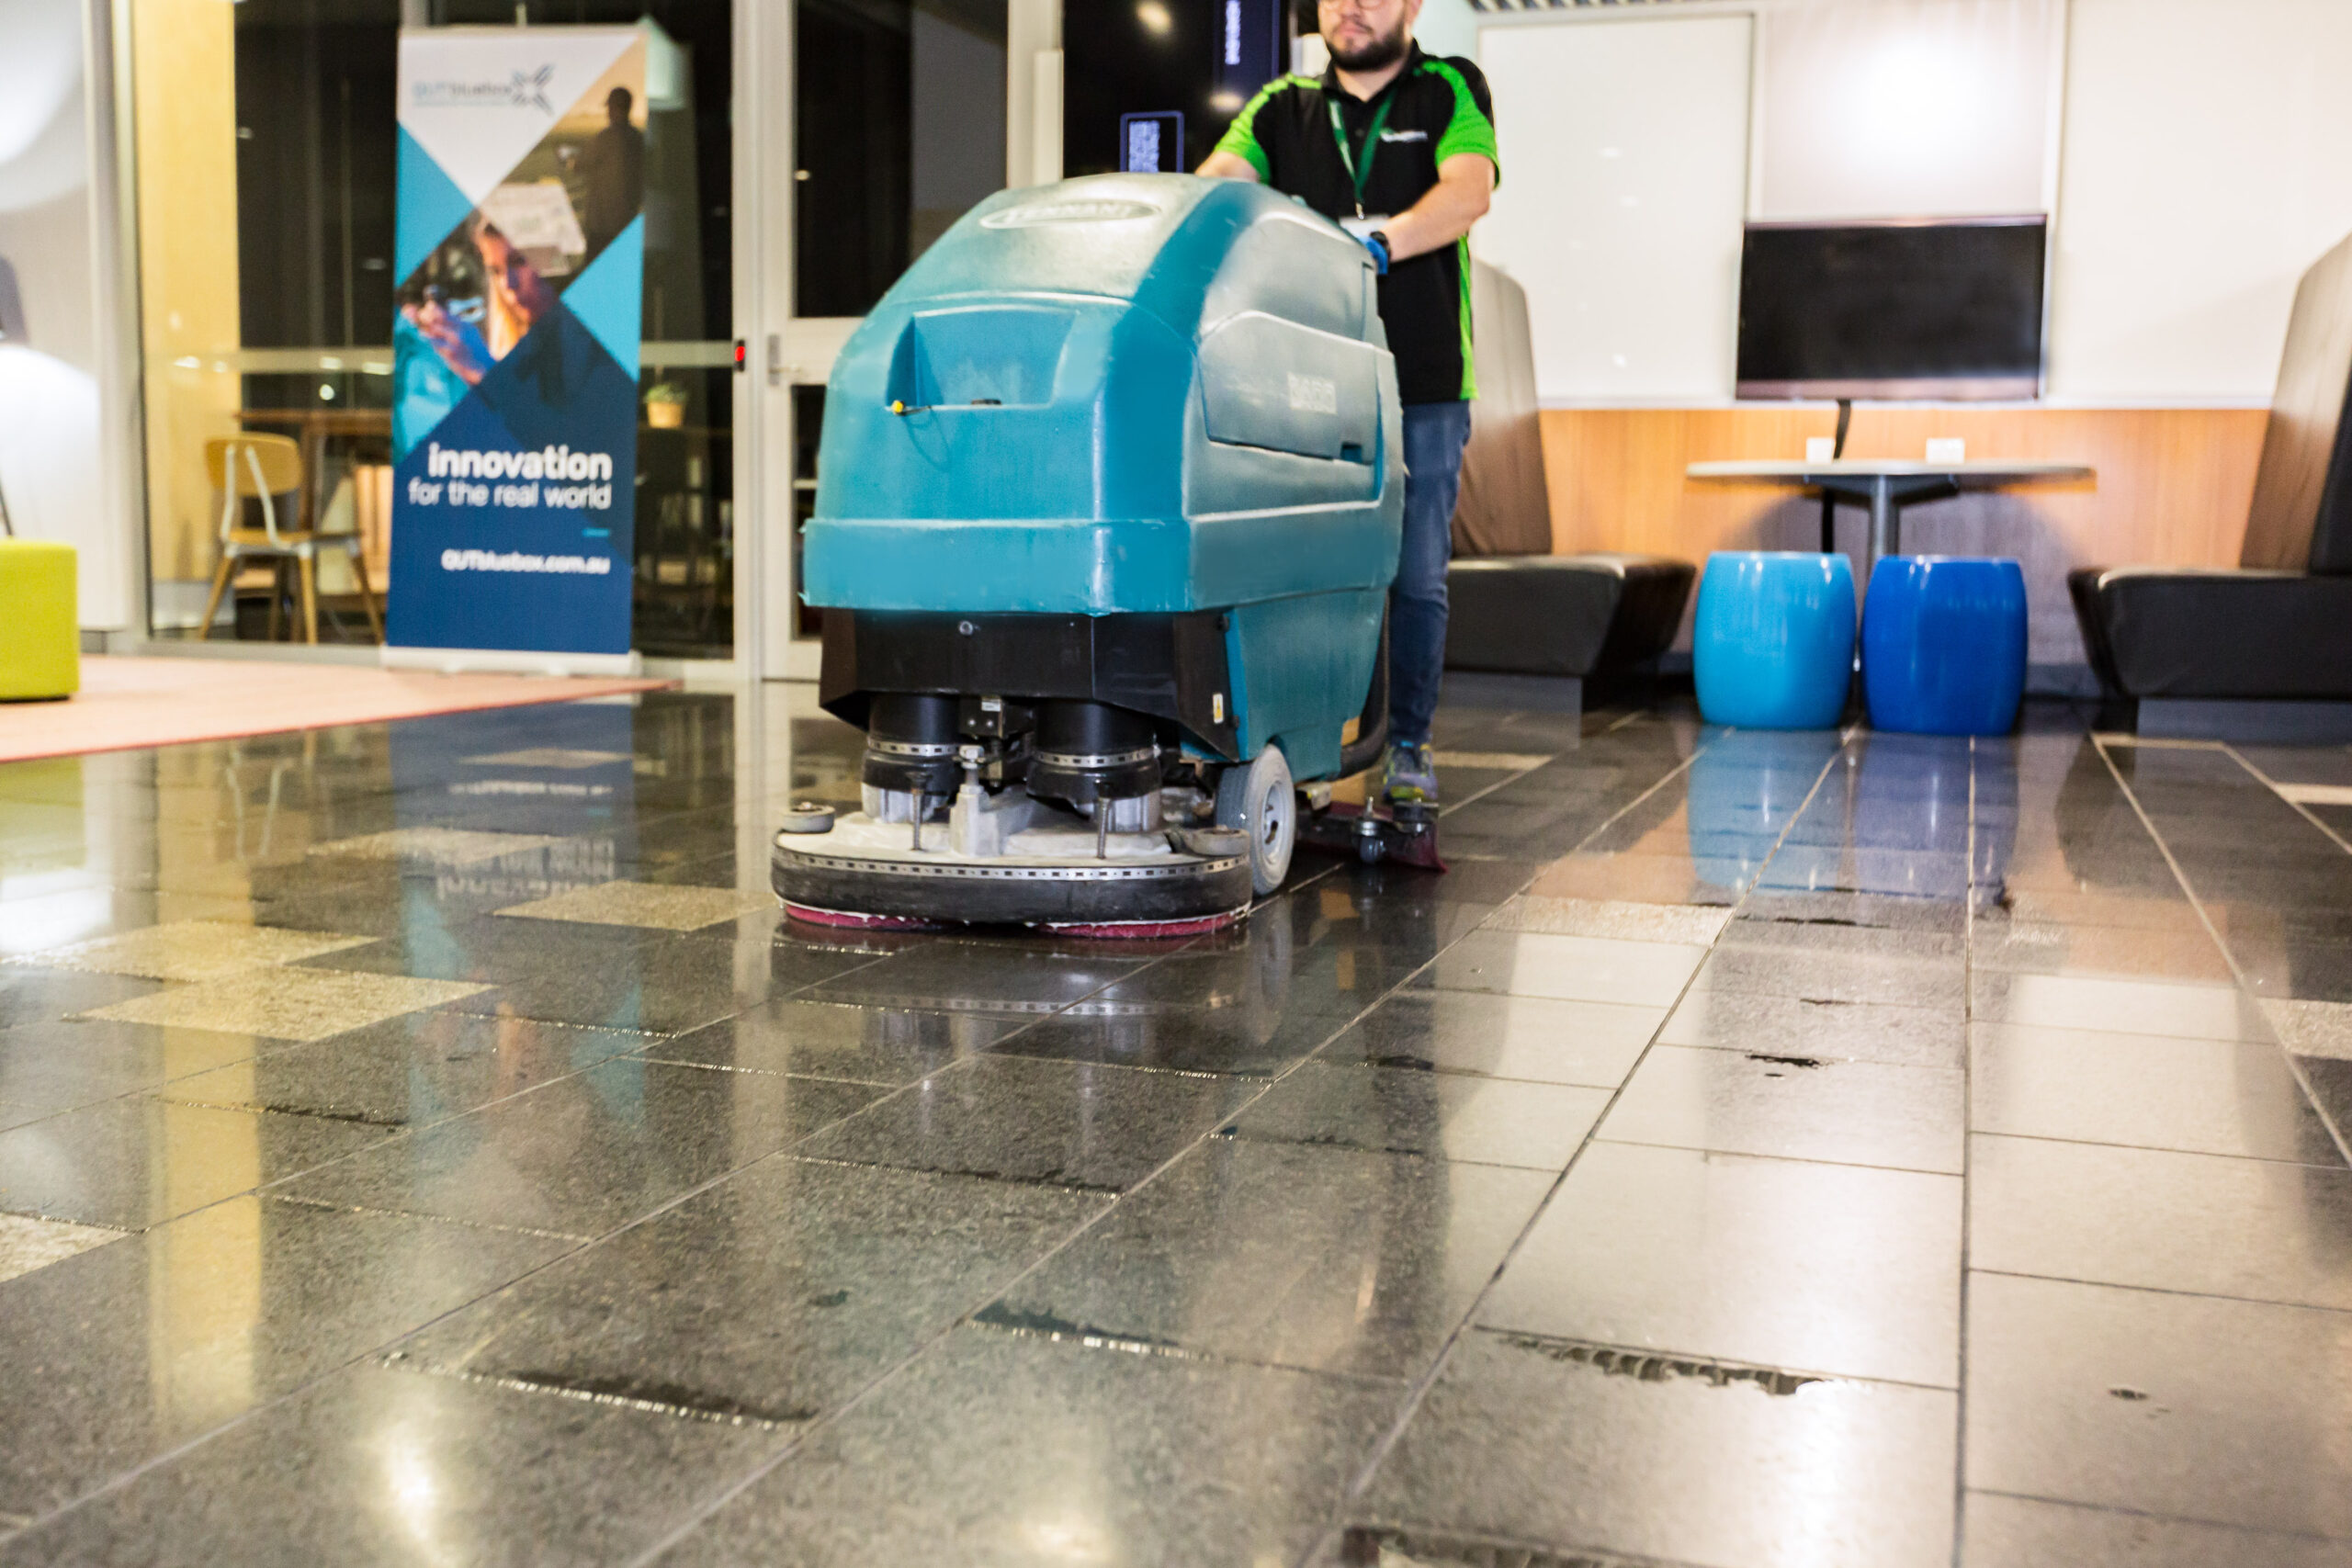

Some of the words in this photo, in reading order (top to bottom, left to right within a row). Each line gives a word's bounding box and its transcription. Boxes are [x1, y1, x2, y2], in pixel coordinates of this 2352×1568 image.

[428, 442, 613, 481] innovation
[408, 476, 443, 505] for
[447, 479, 490, 507] the
[493, 481, 539, 508] real
[544, 482, 612, 510] world
